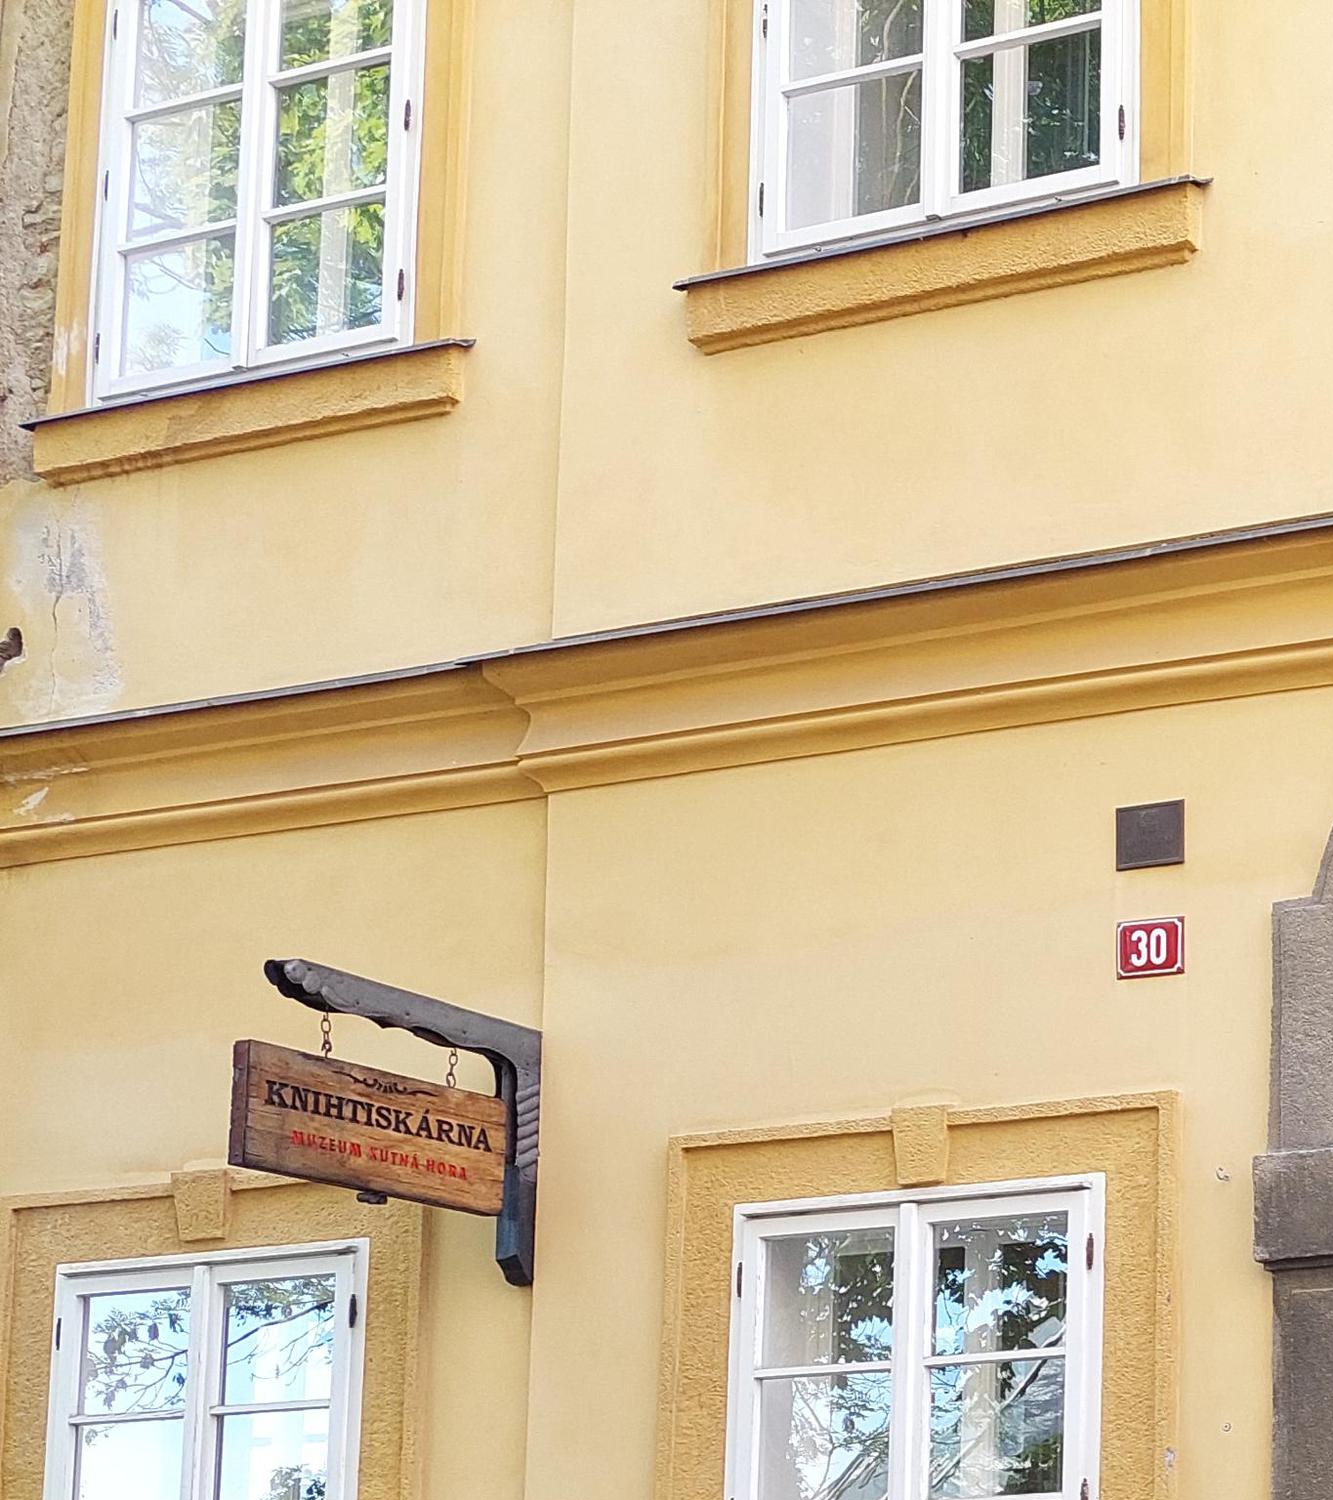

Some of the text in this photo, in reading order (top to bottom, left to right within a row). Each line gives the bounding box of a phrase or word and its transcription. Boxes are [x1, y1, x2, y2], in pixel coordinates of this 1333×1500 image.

[1131, 928, 1167, 967] 30
[265, 1079, 492, 1152] KNIHTISKÁRNA
[291, 1130, 468, 1180] MUZEUM KUTNÁ HORA
